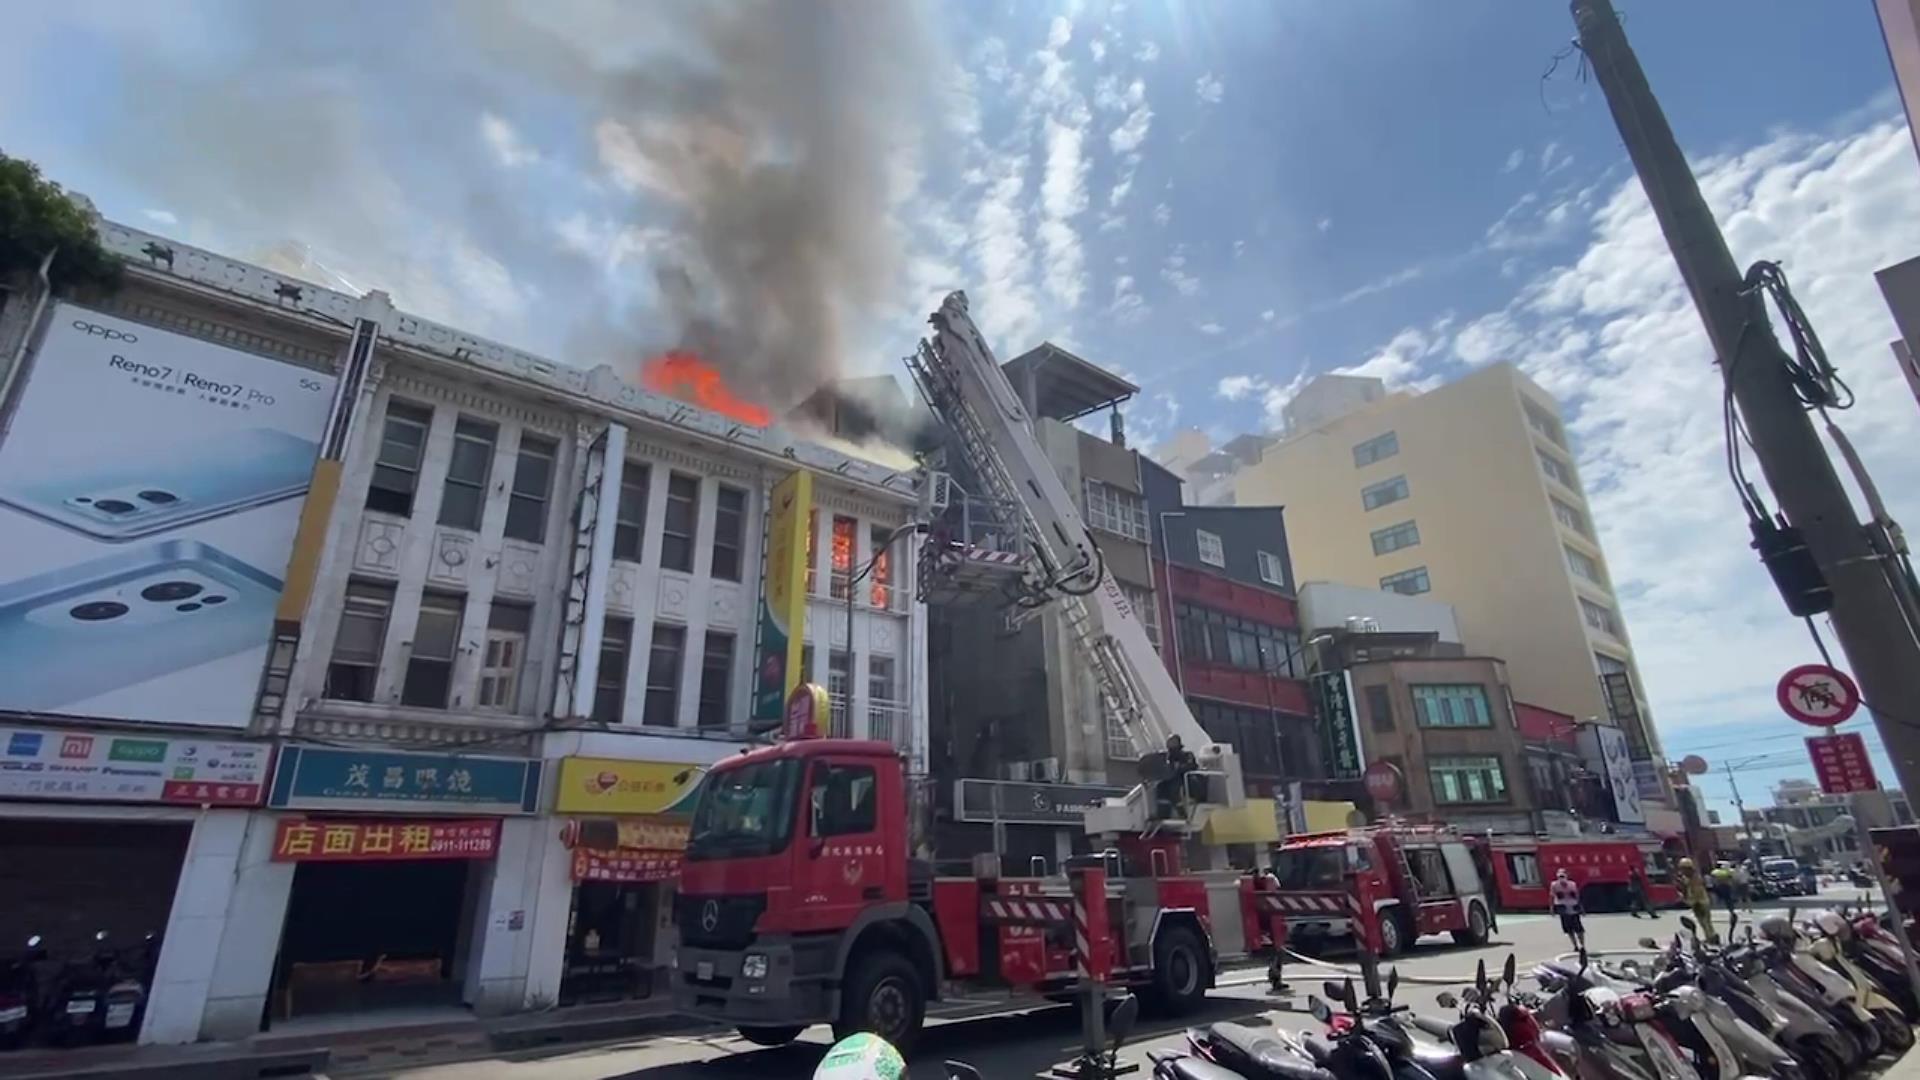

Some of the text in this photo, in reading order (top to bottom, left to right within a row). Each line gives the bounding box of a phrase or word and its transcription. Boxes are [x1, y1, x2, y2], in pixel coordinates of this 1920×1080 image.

[109, 353, 172, 380] Reno7
[183, 372, 243, 397] Reno7
[247, 388, 275, 406] Pro
[299, 377, 321, 392] 5G
[344, 763, 472, 793] 茂昌眼鏡
[280, 824, 431, 855] 店面出租
